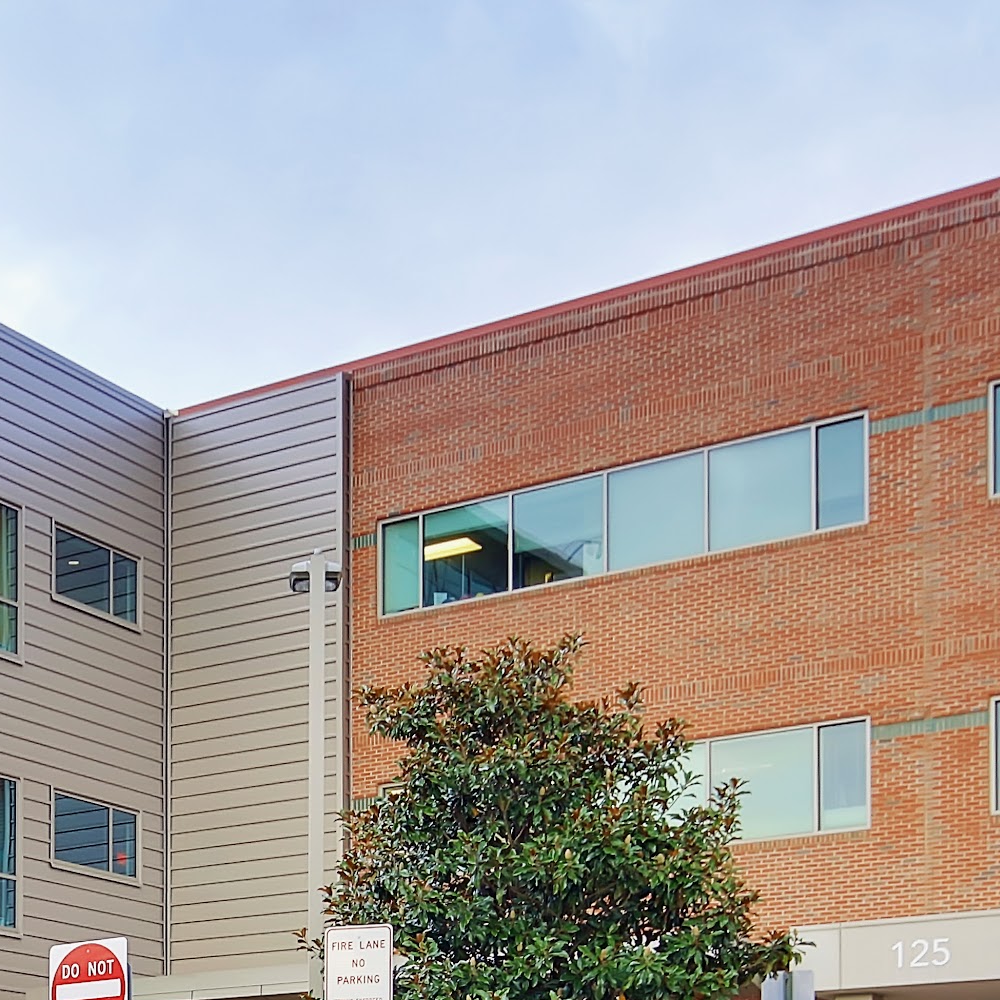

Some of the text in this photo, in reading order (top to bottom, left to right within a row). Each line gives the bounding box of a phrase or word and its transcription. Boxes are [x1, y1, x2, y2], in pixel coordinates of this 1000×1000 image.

[331, 940, 386, 951] FIRE LANE
[891, 937, 951, 968] 125
[351, 958, 366, 968] NO
[62, 959, 115, 980] DO NOT
[337, 974, 380, 985] PARKING
